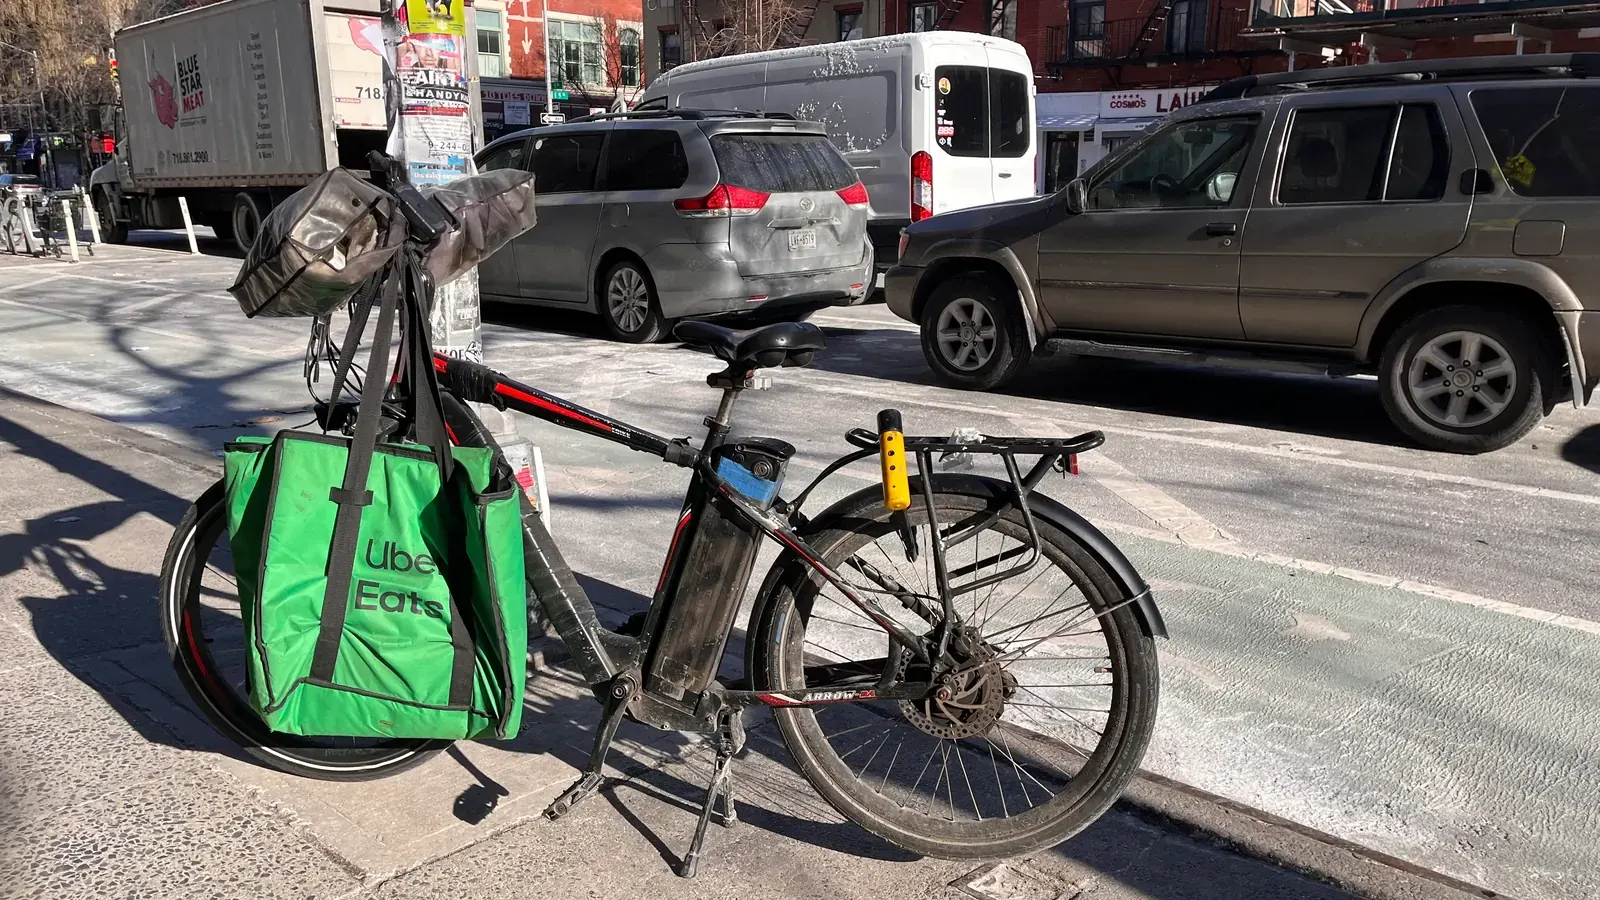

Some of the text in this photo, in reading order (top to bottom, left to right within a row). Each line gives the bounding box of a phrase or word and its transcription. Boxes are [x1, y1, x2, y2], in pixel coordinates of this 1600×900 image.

[177, 53, 199, 78] BLUE
[180, 72, 203, 97] STAR
[183, 91, 205, 114] MEAT
[366, 539, 437, 575] Ube
[354, 580, 444, 619] Eats
